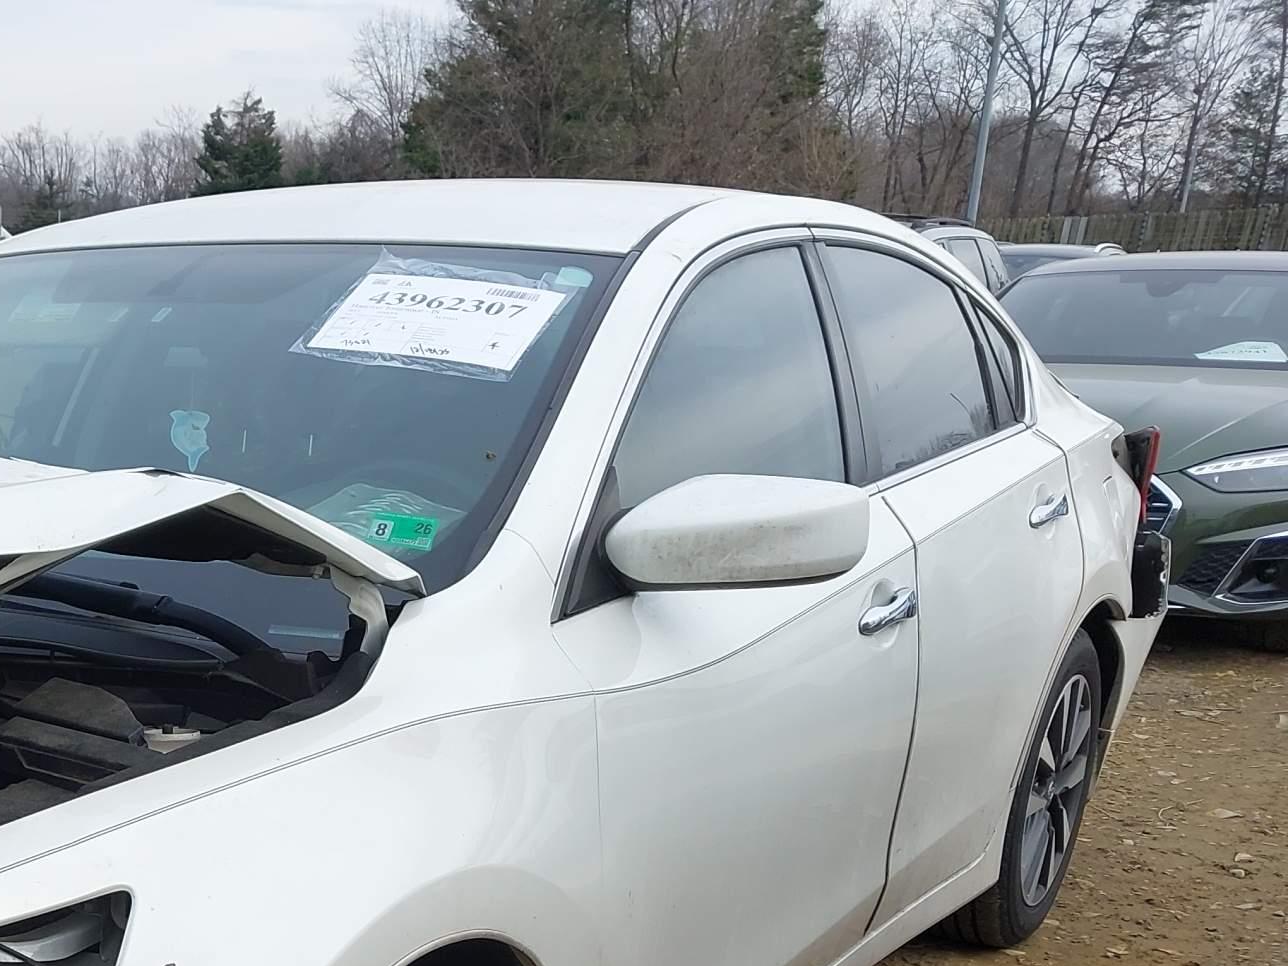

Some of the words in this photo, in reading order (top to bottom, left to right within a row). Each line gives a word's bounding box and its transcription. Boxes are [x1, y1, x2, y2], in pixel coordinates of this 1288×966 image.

[369, 291, 527, 318] 43962307
[375, 523, 387, 536] 8
[416, 522, 432, 535] 26
